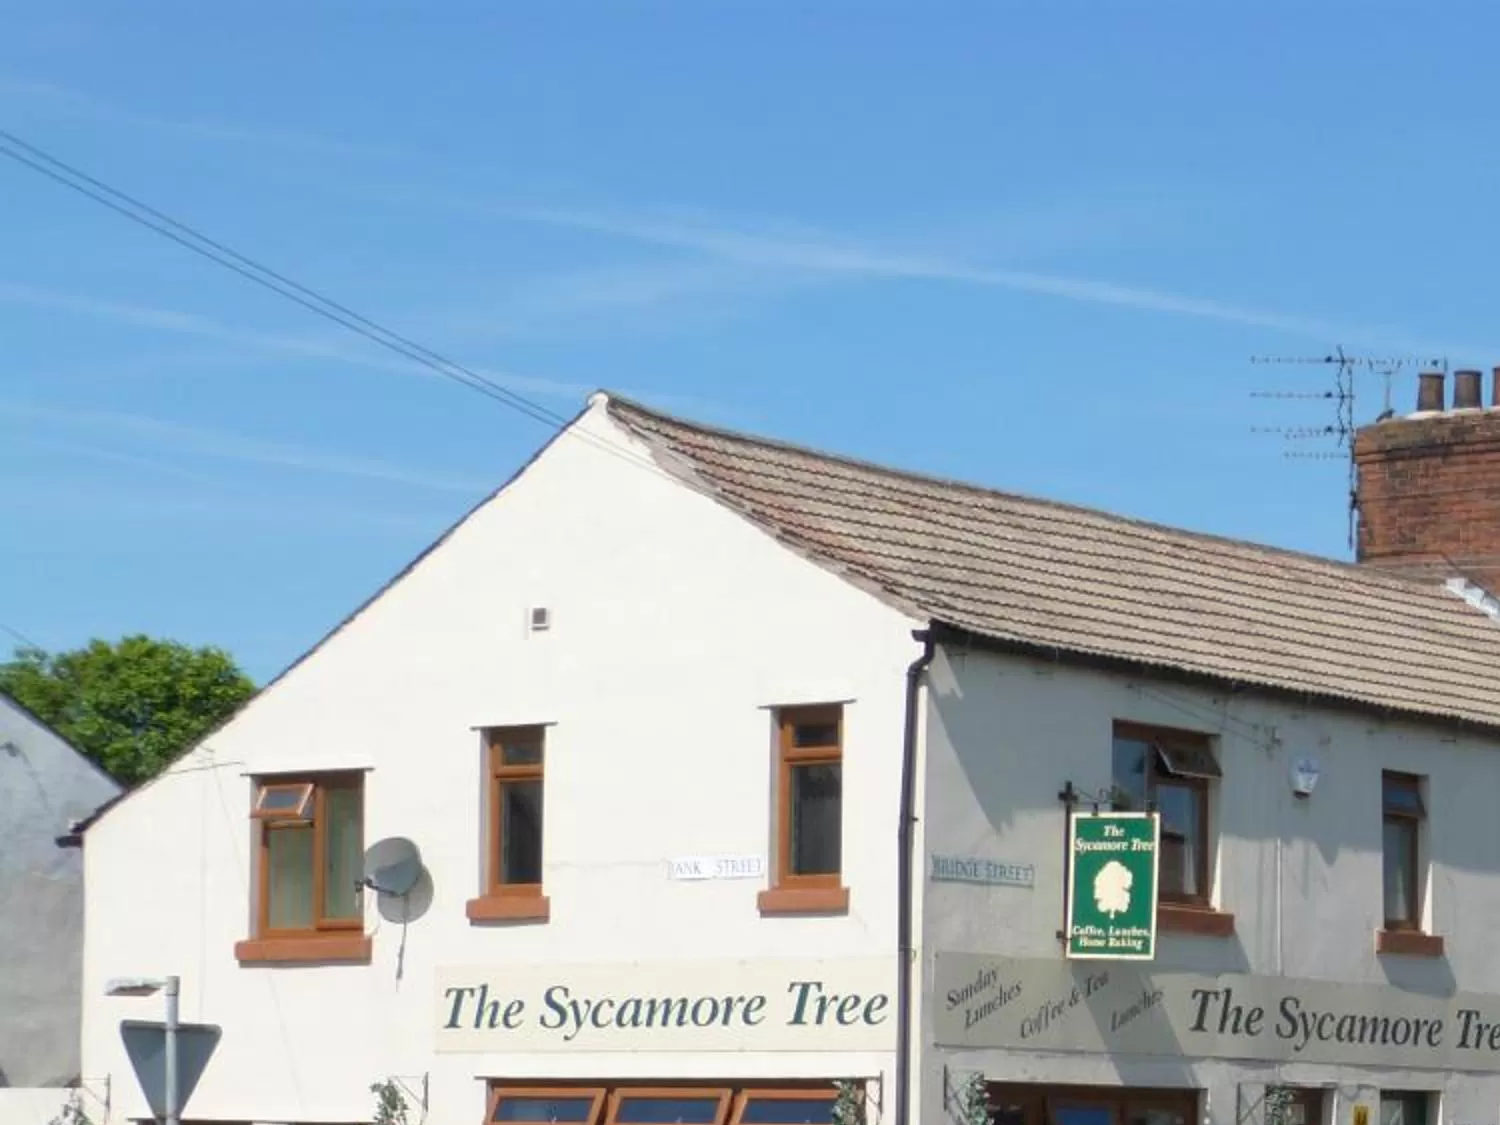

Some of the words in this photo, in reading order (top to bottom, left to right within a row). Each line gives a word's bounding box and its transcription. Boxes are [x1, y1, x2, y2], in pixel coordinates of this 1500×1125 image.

[1075, 837, 1129, 855] Sycamore
[1131, 837, 1155, 851] Tree
[1104, 824, 1125, 837] The
[443, 983, 525, 1030] The
[539, 984, 767, 1042] Sycamore
[786, 980, 889, 1027] Tree
[945, 965, 998, 1011] Sunday
[964, 980, 1023, 1030] Lunches
[1020, 998, 1066, 1040] Coffee
[1084, 970, 1110, 997] Tea
[1110, 987, 1164, 1032] Lunches
[1188, 986, 1265, 1037] The
[1275, 995, 1444, 1052] Sycamore
